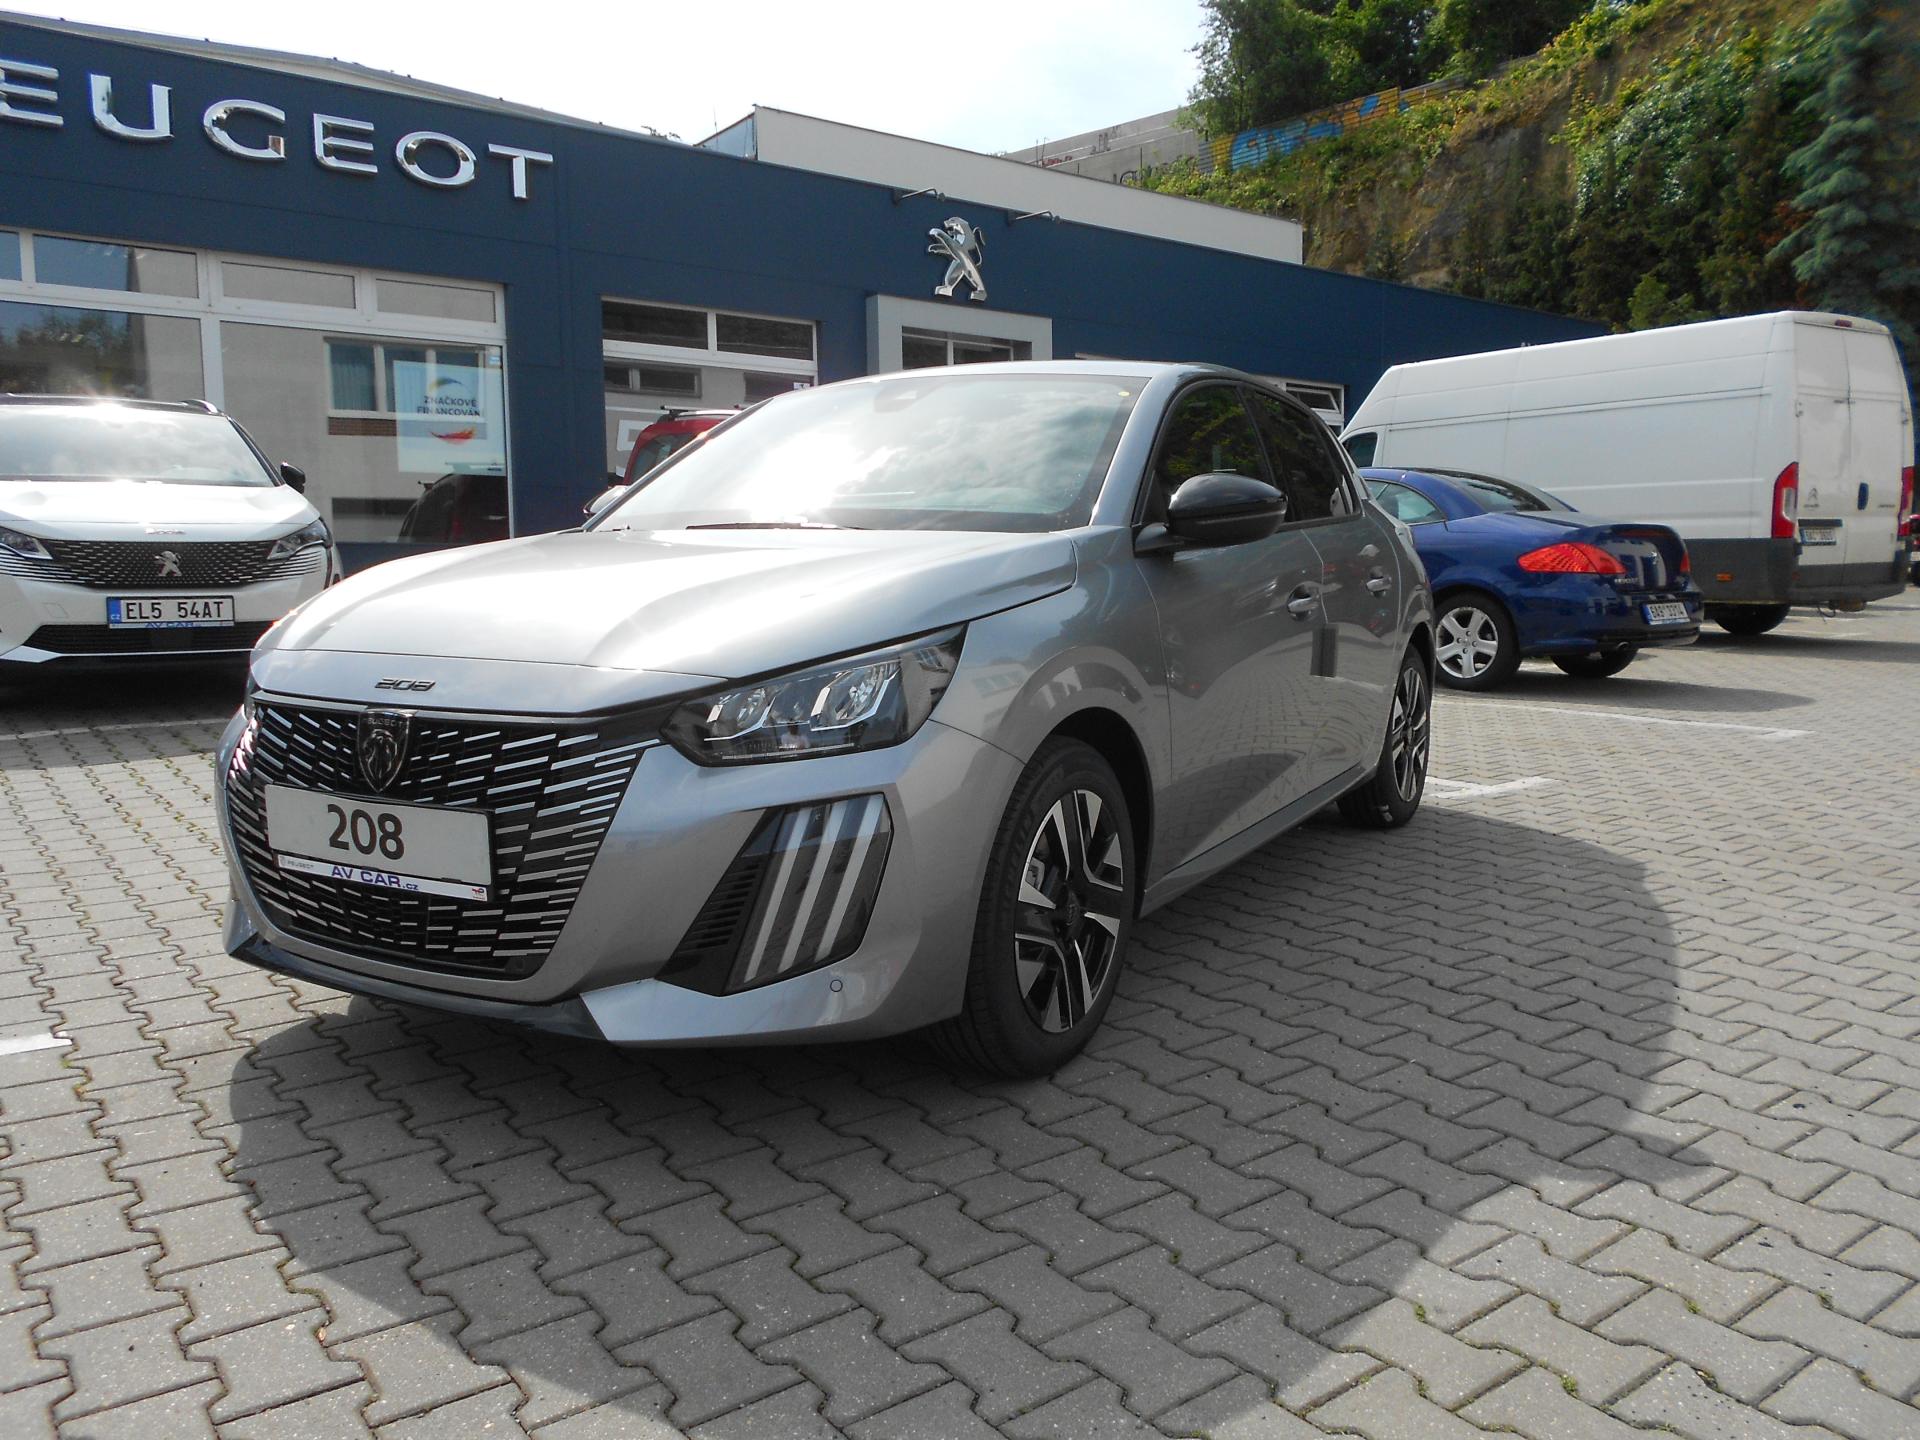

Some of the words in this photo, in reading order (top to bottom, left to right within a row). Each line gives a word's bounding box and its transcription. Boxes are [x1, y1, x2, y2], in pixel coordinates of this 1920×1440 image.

[417, 406, 484, 417] FINANCOVÁN
[126, 602, 162, 620] EL5
[177, 601, 223, 619] 54AT
[374, 677, 436, 692] 208
[327, 803, 405, 860] 208
[331, 865, 354, 879] AV
